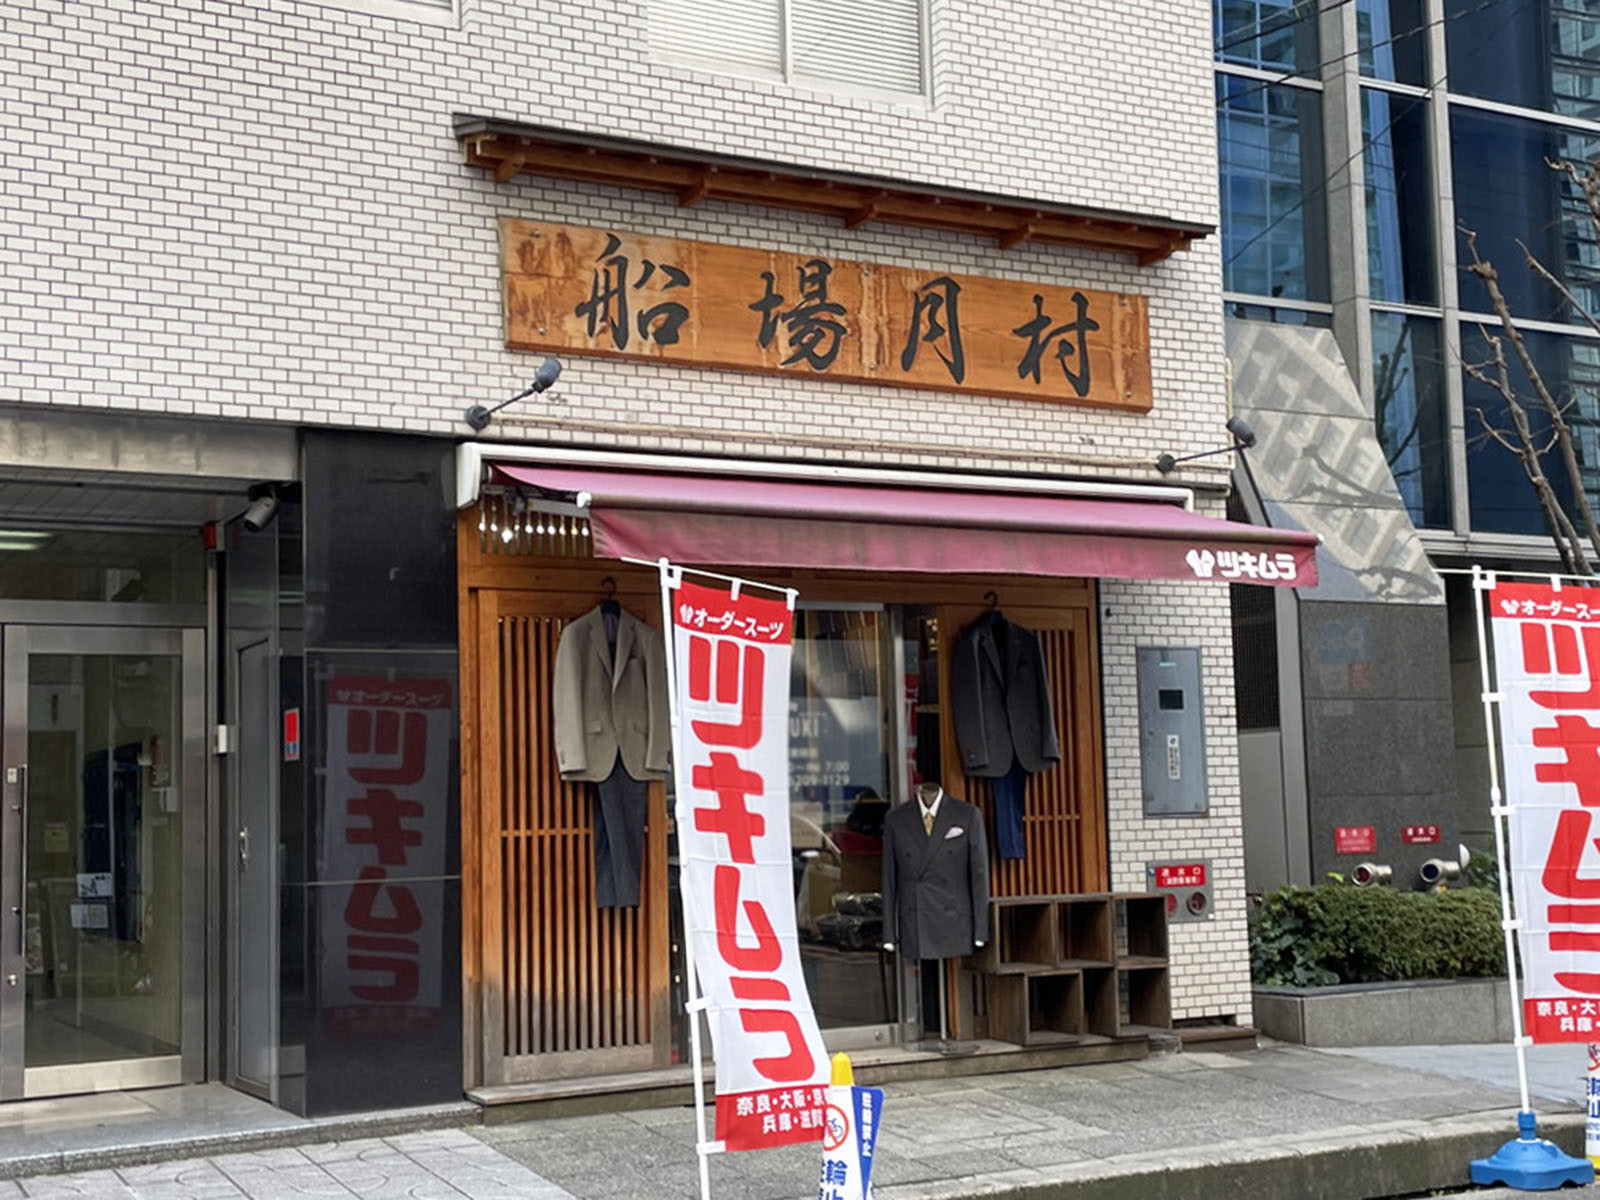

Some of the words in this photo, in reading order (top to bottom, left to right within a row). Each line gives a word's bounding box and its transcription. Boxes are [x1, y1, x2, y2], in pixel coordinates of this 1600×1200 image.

[576, 233, 1100, 397] 船場月村
[1216, 550, 1297, 580] ツキムラ
[693, 607, 784, 640] オーダースーツ
[689, 635, 815, 1082] ツキムラ
[1536, 1001, 1600, 1017] 奈良・大
